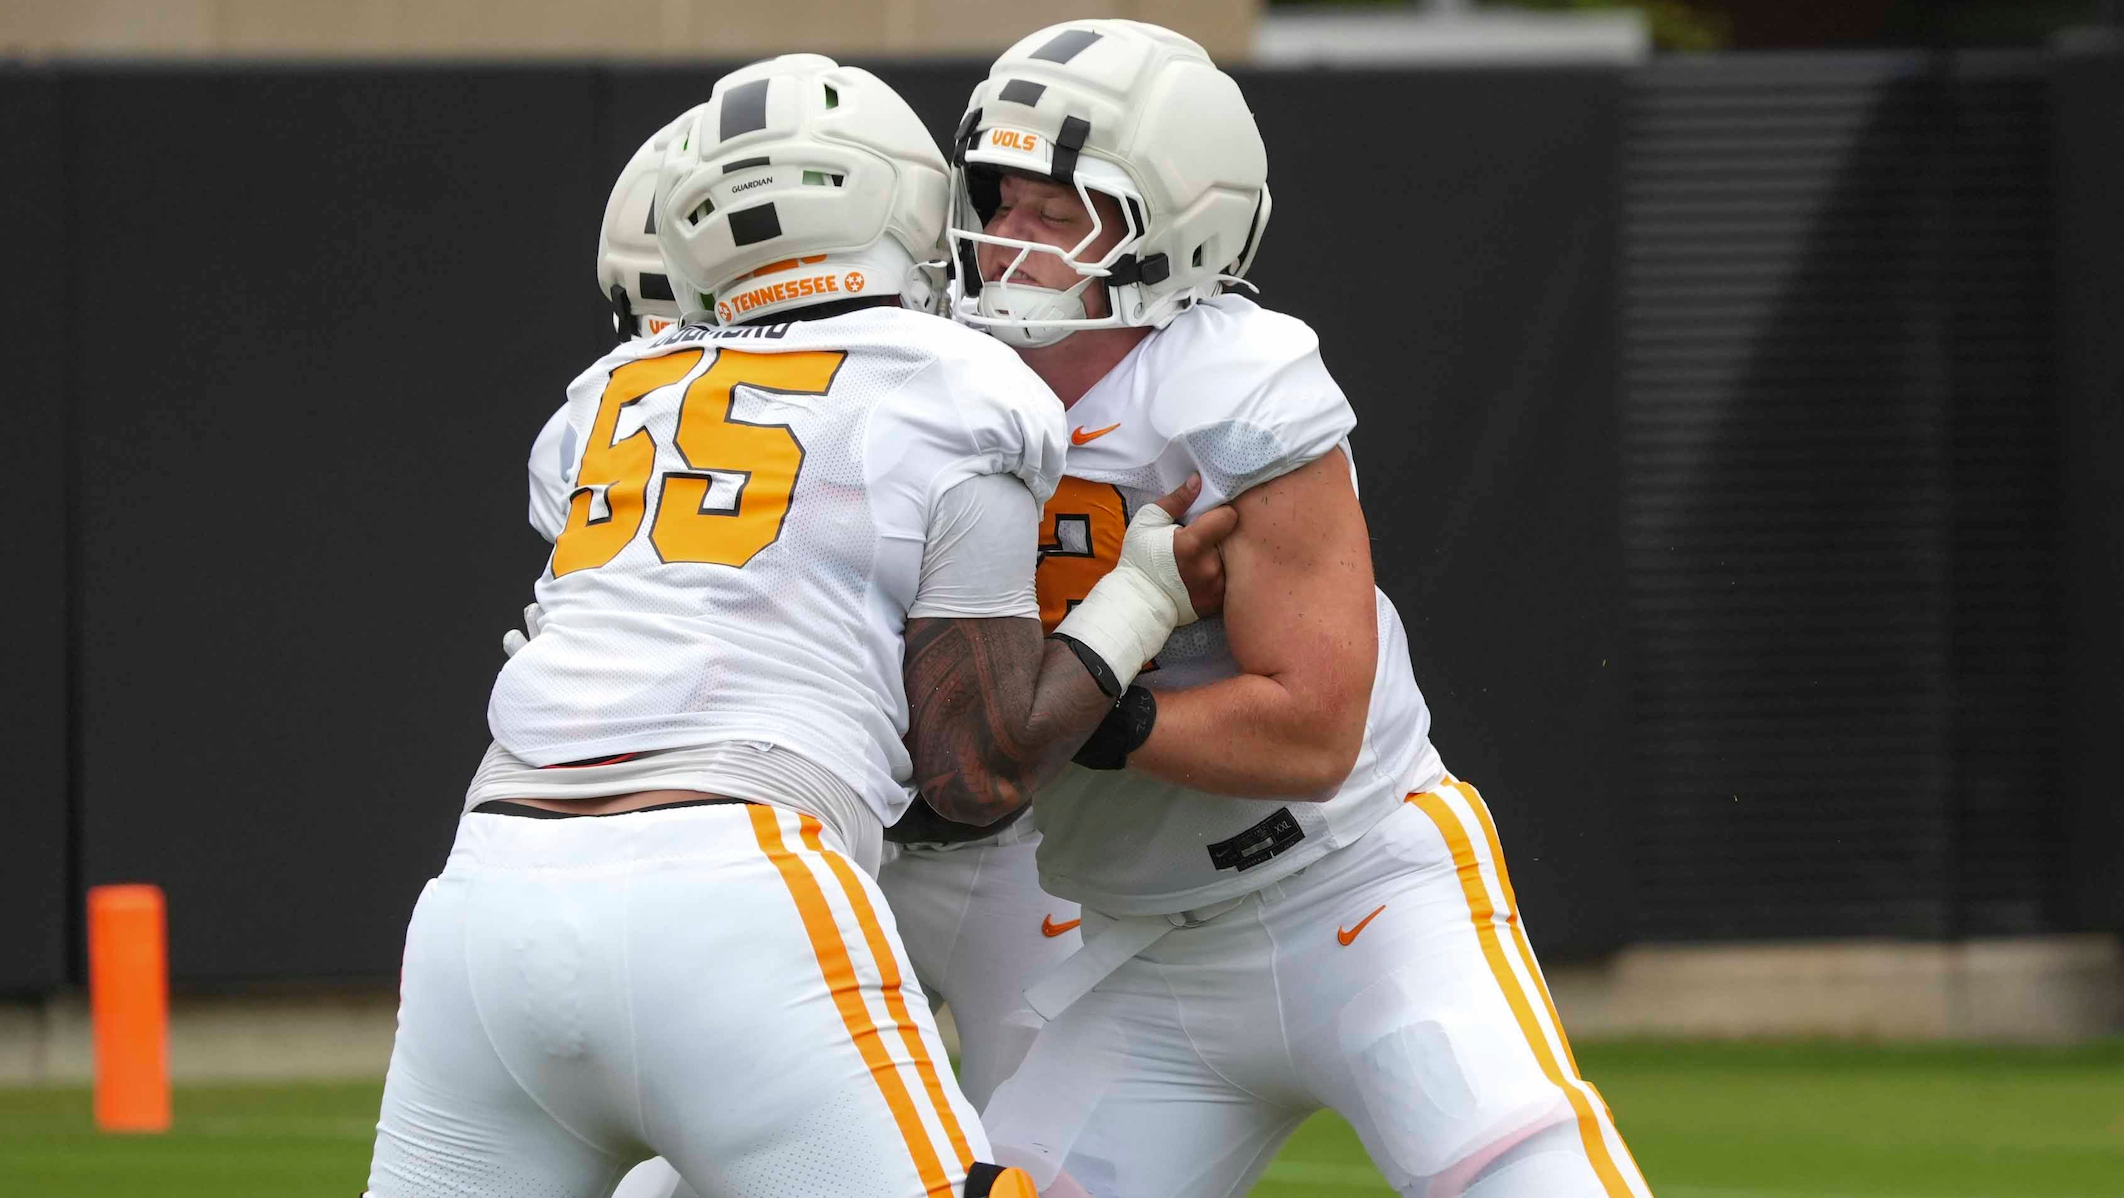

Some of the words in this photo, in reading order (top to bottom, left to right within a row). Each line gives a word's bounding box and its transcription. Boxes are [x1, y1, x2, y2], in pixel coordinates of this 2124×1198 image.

[992, 129, 1037, 151] VOLS
[731, 176, 773, 194] GUARDIAN
[731, 275, 839, 315] TENNESSEE
[551, 346, 849, 580] 55
[1273, 820, 1292, 836] XXL
